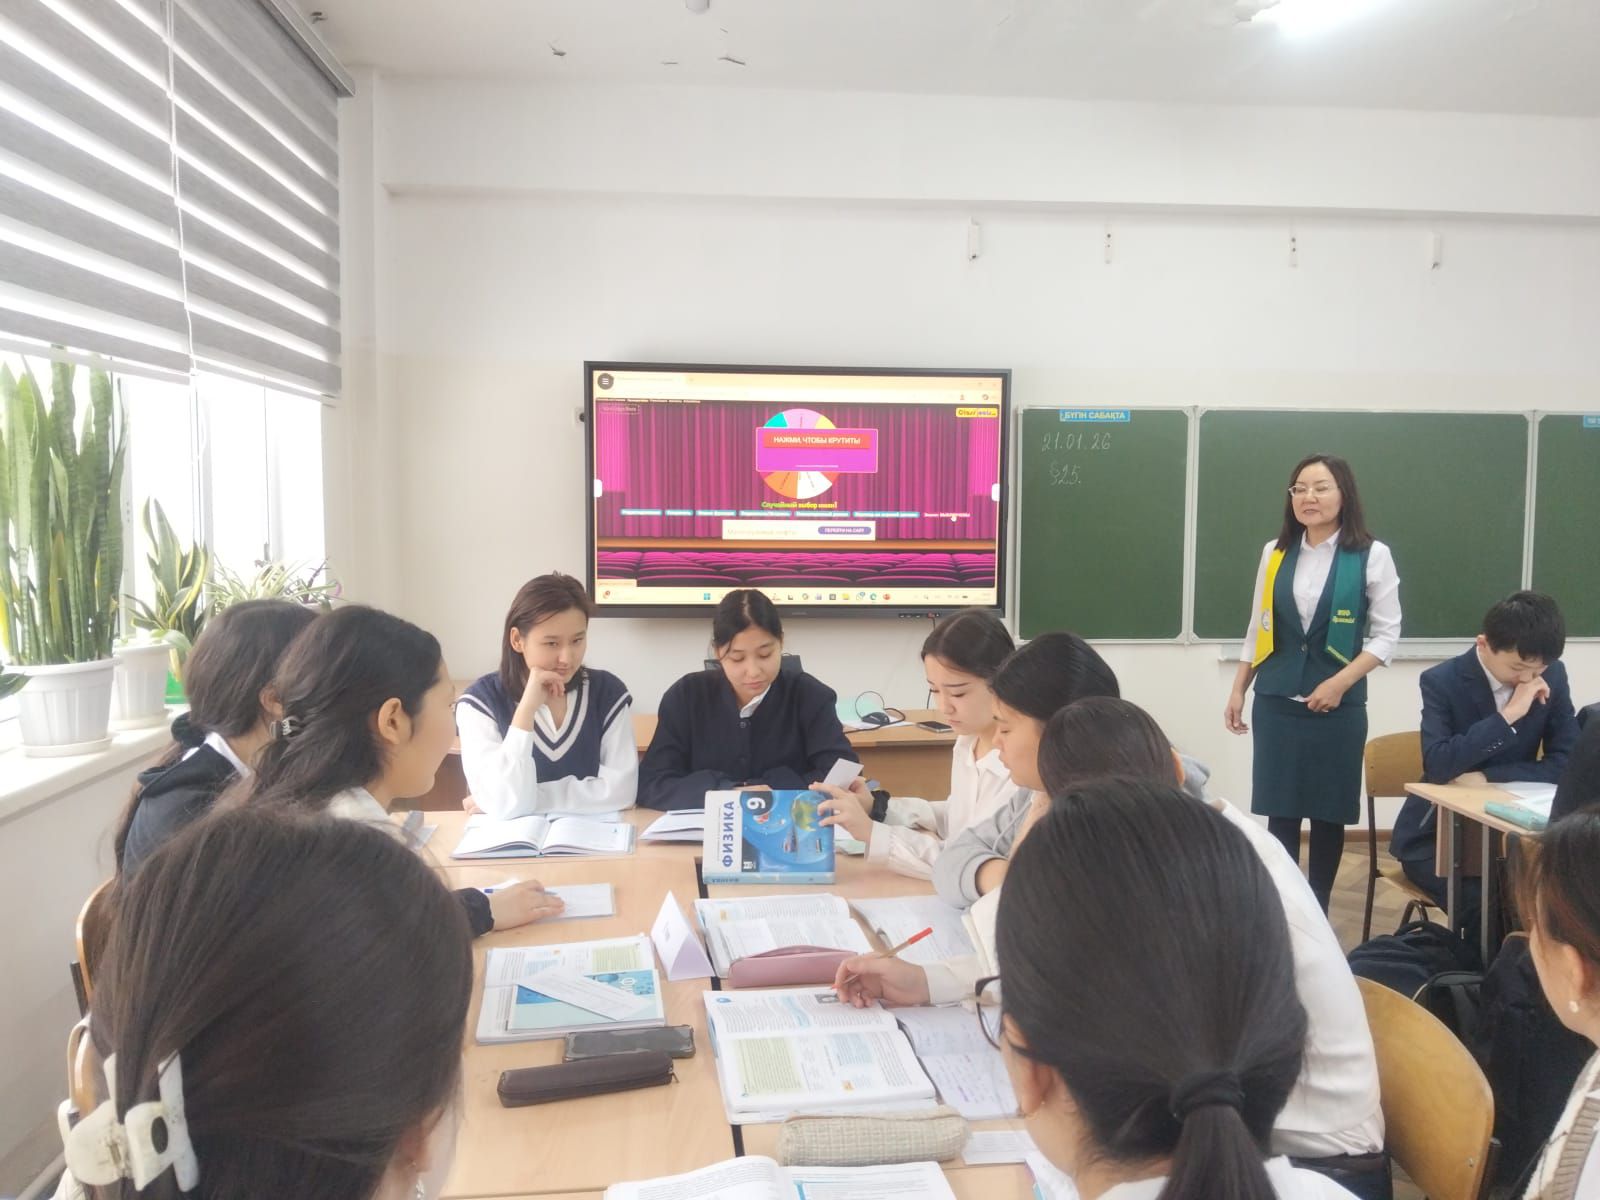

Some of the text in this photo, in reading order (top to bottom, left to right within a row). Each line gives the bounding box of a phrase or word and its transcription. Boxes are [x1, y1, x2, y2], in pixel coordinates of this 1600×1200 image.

[802, 436, 827, 444] ЧТОБЫ
[746, 797, 766, 810] 9
[722, 801, 735, 867] ФИЗИКА
